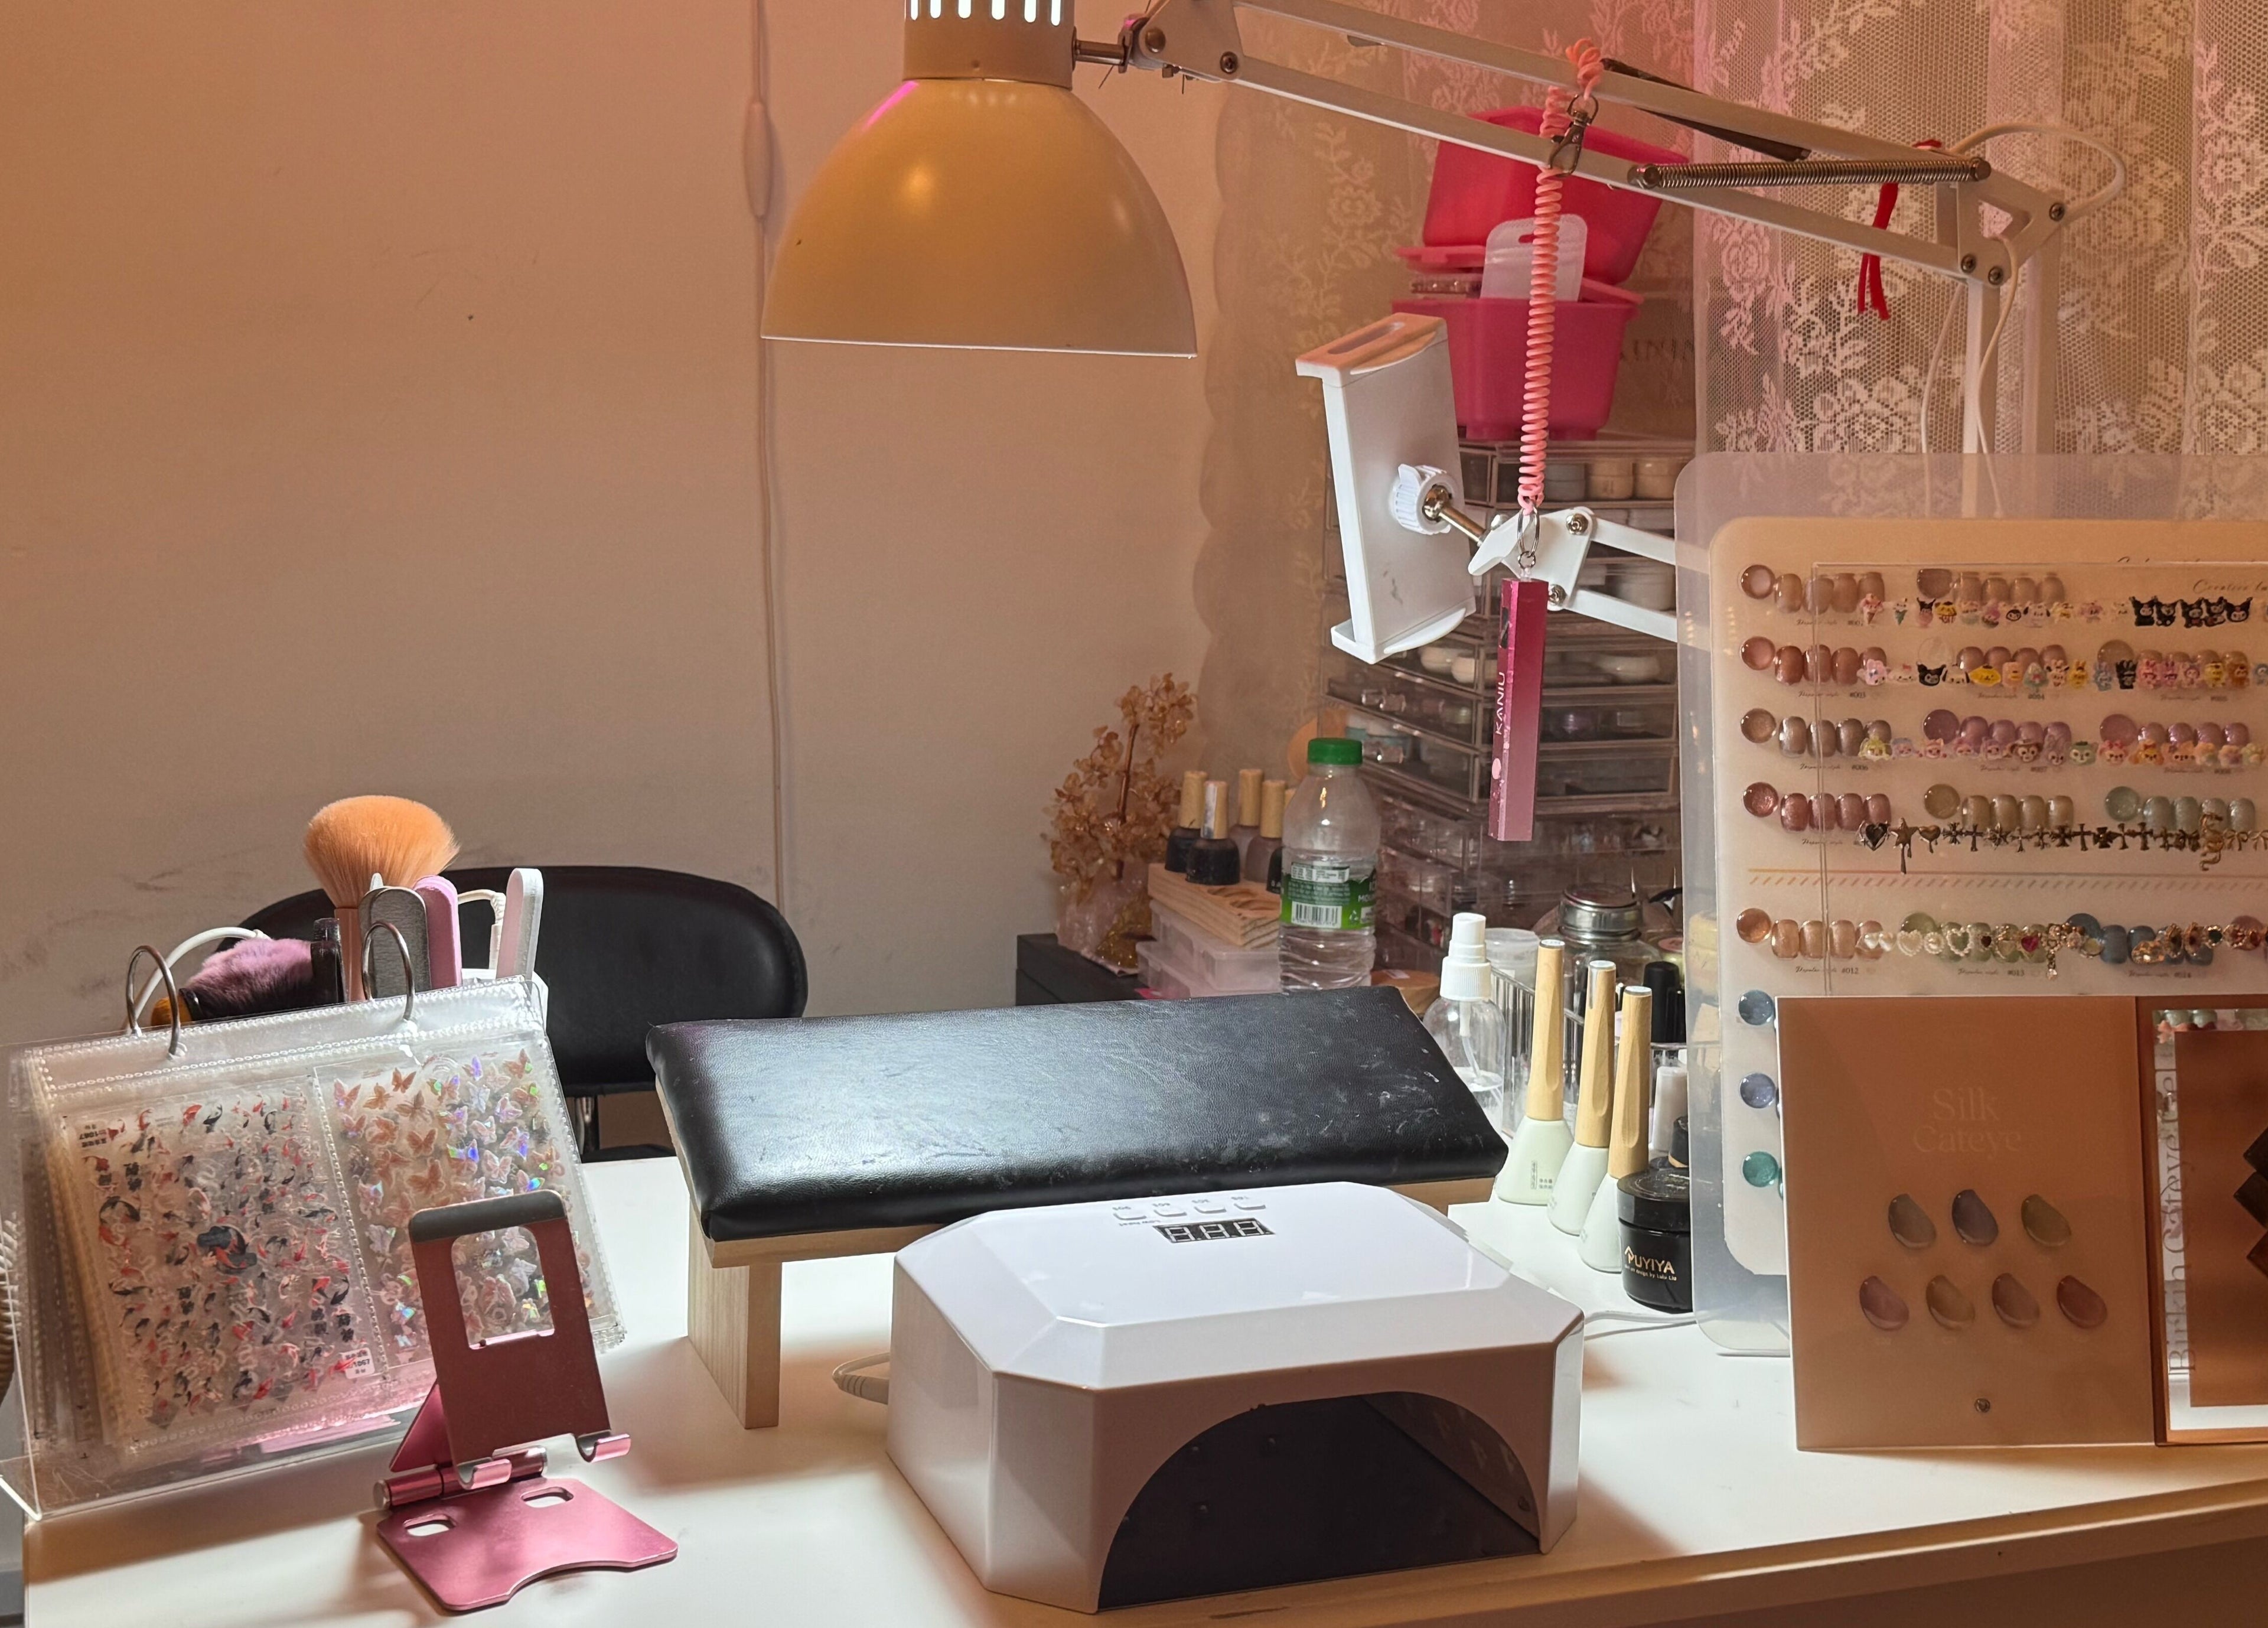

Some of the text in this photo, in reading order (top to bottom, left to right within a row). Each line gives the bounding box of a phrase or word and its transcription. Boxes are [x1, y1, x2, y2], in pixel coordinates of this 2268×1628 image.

[1495, 671, 1506, 735] KANIU
[2007, 969, 2025, 977] #013
[1933, 1086, 2000, 1122] Silk
[1912, 1124, 2022, 1160] Cateye
[2162, 1134, 2194, 1253] Cateye
[1624, 1246, 1675, 1275] PUYIYA
[2165, 1264, 2195, 1373] Birkin
